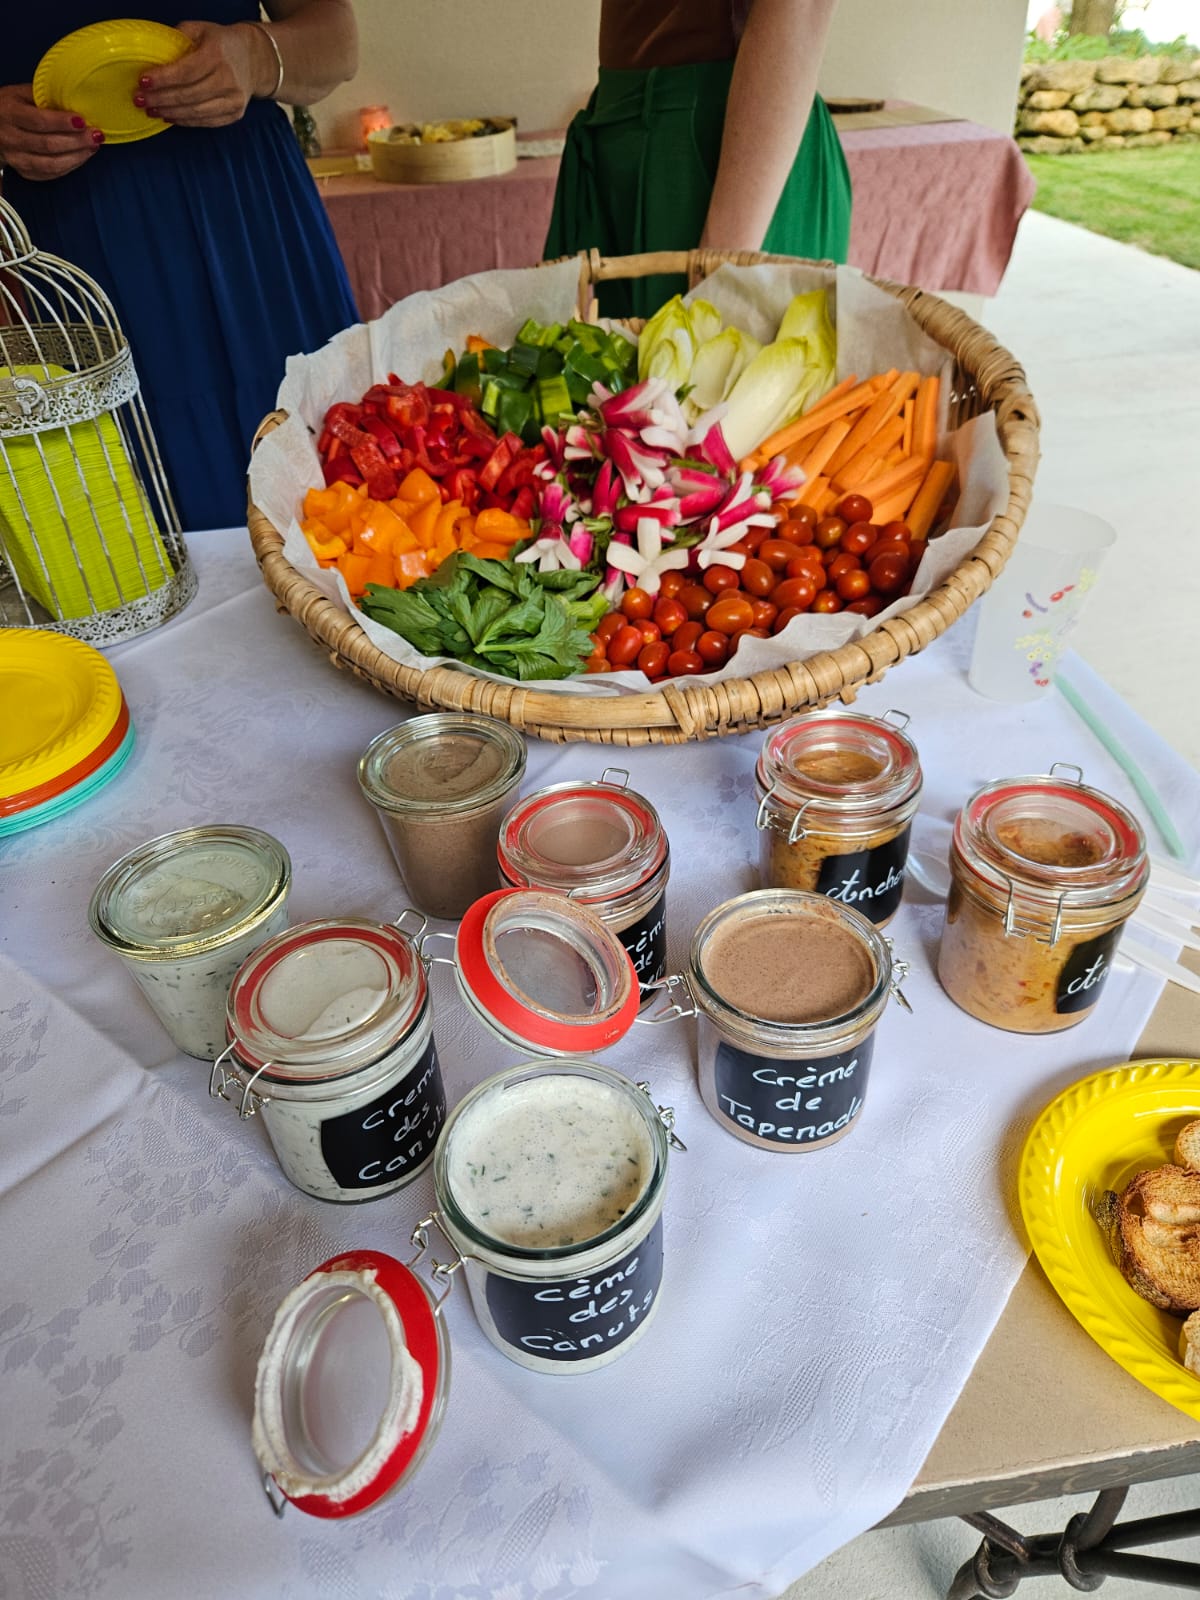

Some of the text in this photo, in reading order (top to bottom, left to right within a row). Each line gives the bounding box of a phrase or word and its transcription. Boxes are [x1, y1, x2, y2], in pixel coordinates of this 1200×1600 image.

[752, 1058, 858, 1089] Crème
[775, 1091, 823, 1112] de
[393, 1102, 430, 1142] des
[520, 1288, 653, 1352] Canuts
[568, 1288, 634, 1323] des
